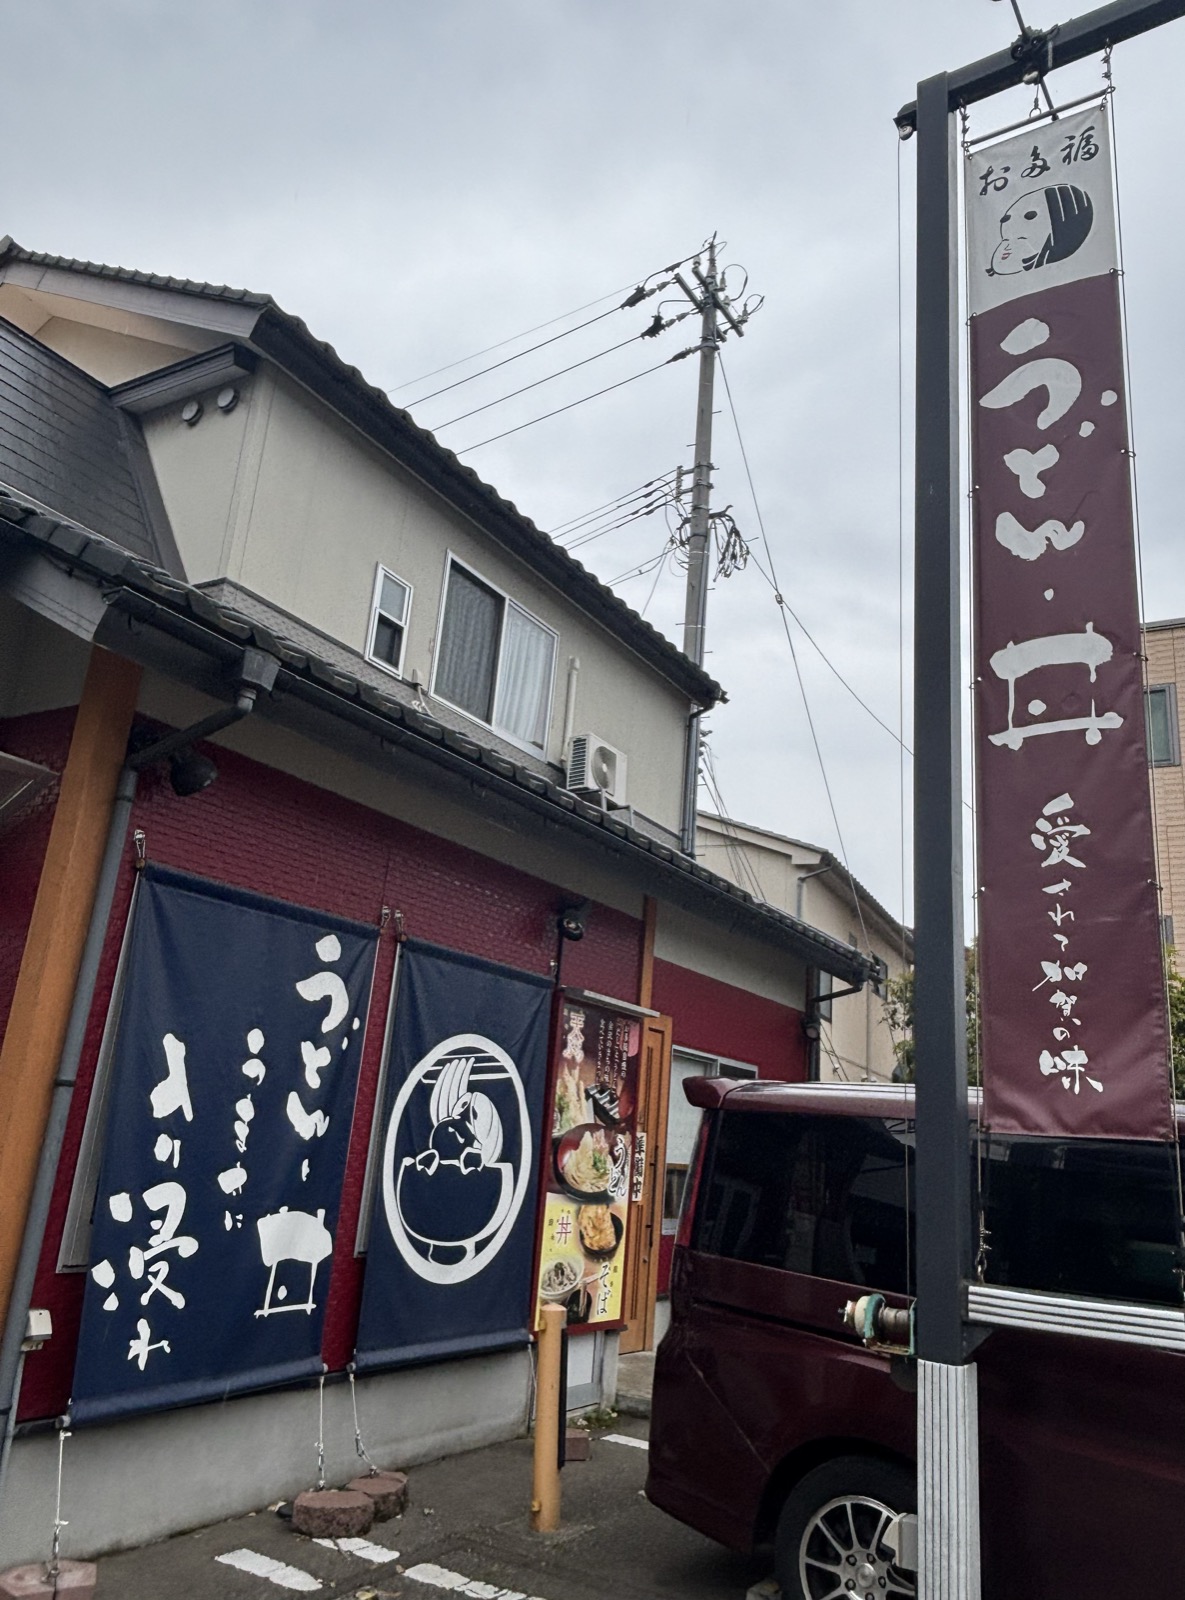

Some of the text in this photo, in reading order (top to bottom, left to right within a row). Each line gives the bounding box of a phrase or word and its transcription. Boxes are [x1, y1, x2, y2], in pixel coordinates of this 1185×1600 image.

[979, 125, 1100, 196] お多福
[1030, 792, 1104, 1095] 愛されて加賀の味
[596, 1263, 610, 1316] そば
